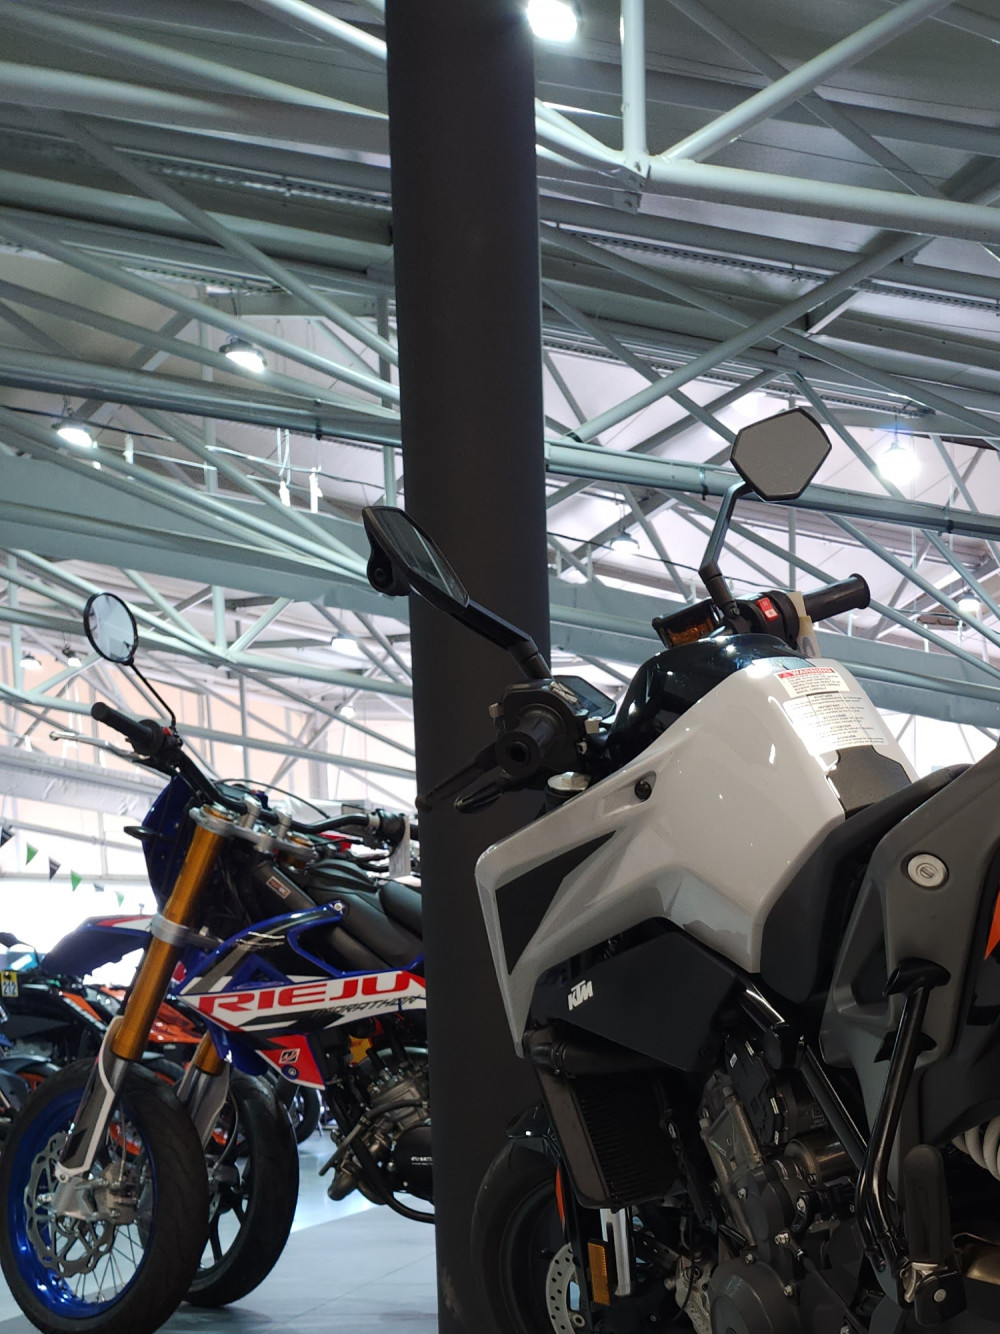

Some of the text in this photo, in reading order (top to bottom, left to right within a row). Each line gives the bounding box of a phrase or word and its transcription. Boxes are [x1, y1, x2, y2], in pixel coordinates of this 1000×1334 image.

[792, 668, 833, 676] WARNING
[197, 972, 411, 1014] RIEJU
[568, 980, 594, 1011] KTM
